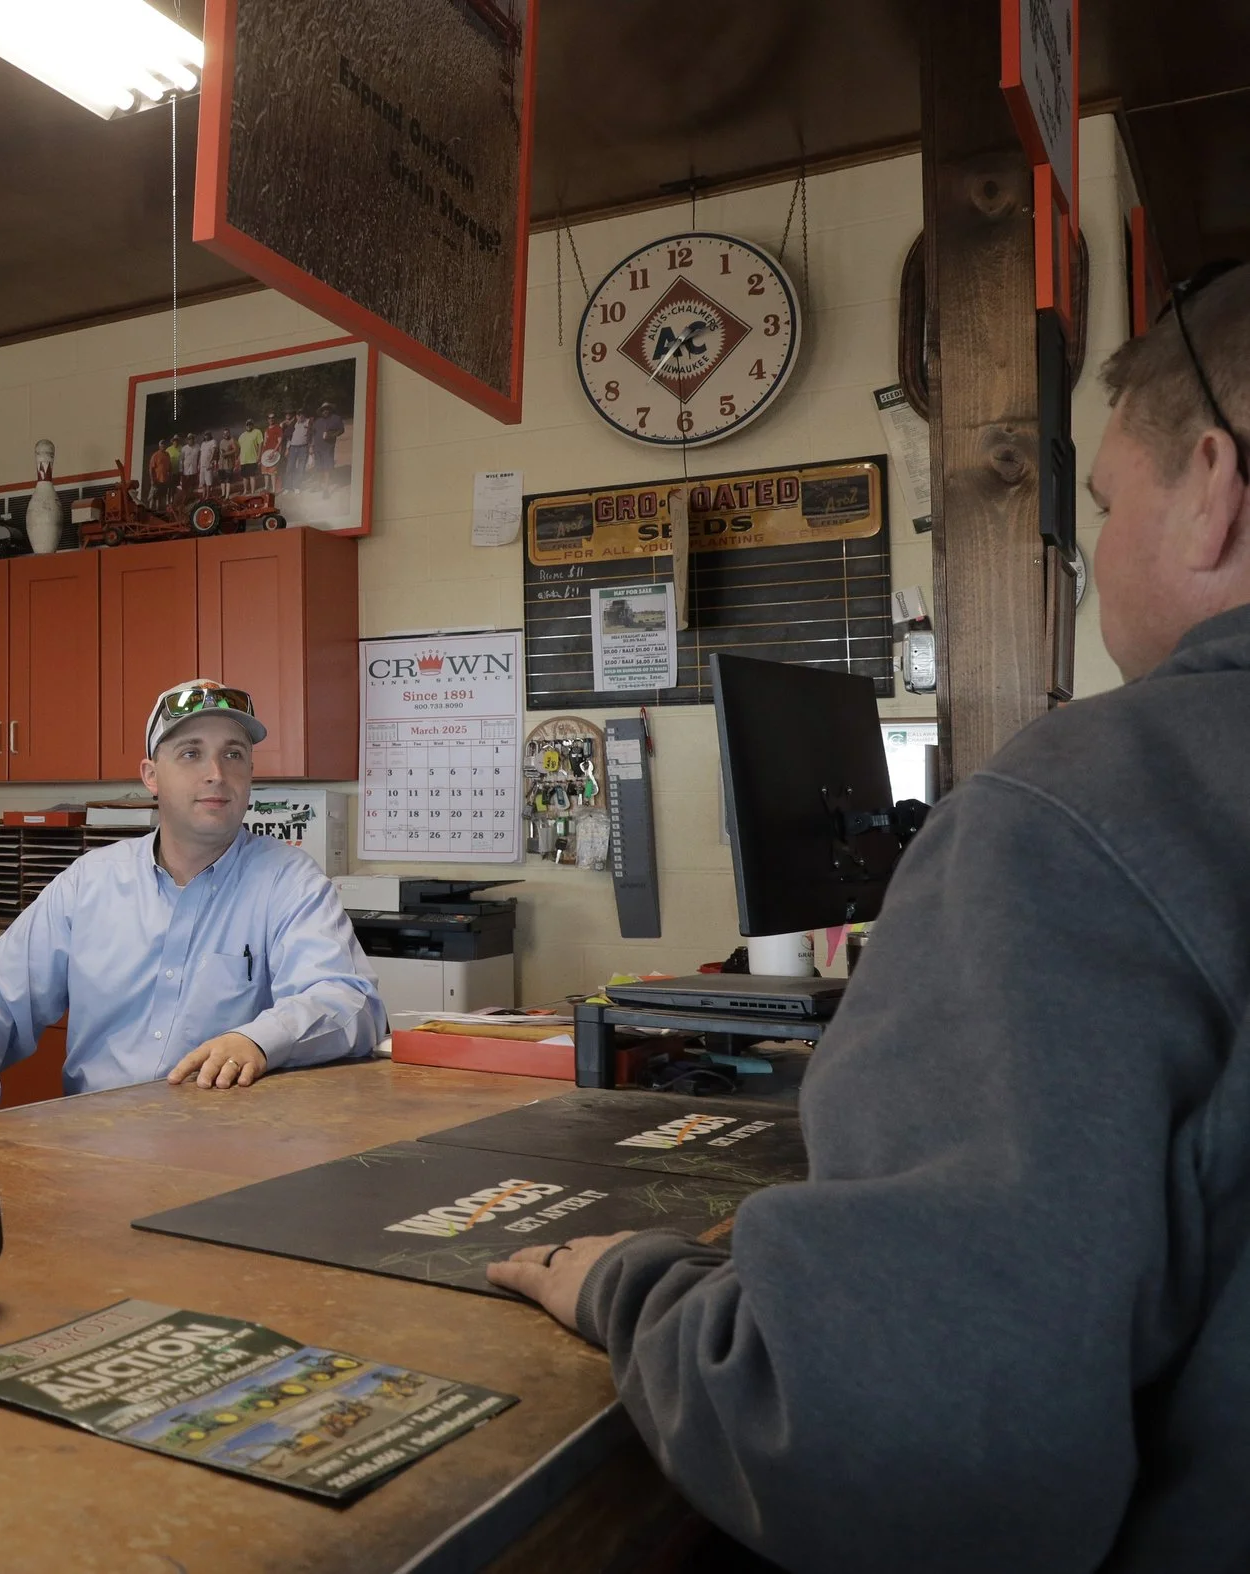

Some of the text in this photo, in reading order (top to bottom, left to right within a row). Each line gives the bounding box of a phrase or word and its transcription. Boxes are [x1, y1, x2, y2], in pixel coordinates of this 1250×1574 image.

[340, 54, 474, 193] Expand On-Farm
[388, 150, 501, 255] Grain Storage?
[668, 248, 693, 270] 12
[720, 254, 731, 275] 1
[629, 268, 650, 291] 11
[747, 273, 765, 296] 2
[600, 302, 626, 324] 10
[648, 305, 719, 341] ALLIS-CHALMERS
[763, 314, 780, 336] 3
[591, 343, 607, 363] 9
[748, 359, 766, 380] 4
[605, 381, 620, 402] 8
[720, 395, 736, 416] 5
[636, 407, 650, 428] 7
[677, 411, 694, 432] 6
[564, 551, 593, 560] FOR
[602, 546, 629, 556] ALL
[690, 534, 764, 549] PLANTING
[436, 674, 513, 683] SERVICE
[403, 690, 474, 701] Since 1891
[410, 725, 467, 735] March 2025
[367, 768, 500, 776] 2 3 4 5 6 7 8
[614, 1113, 739, 1149] WOODS
[707, 1136, 739, 1147] GET
[726, 1124, 762, 1139] AFTER
[383, 1178, 564, 1238] WOODS
[504, 1189, 610, 1232] GET AFTER IT
[56, 1323, 176, 1374] ANNUAL SPRING
[35, 1323, 232, 1402] AUCTION
[116, 1378, 182, 1403] IRON
[166, 1360, 227, 1383] CITY,
[207, 1347, 254, 1363] GA
